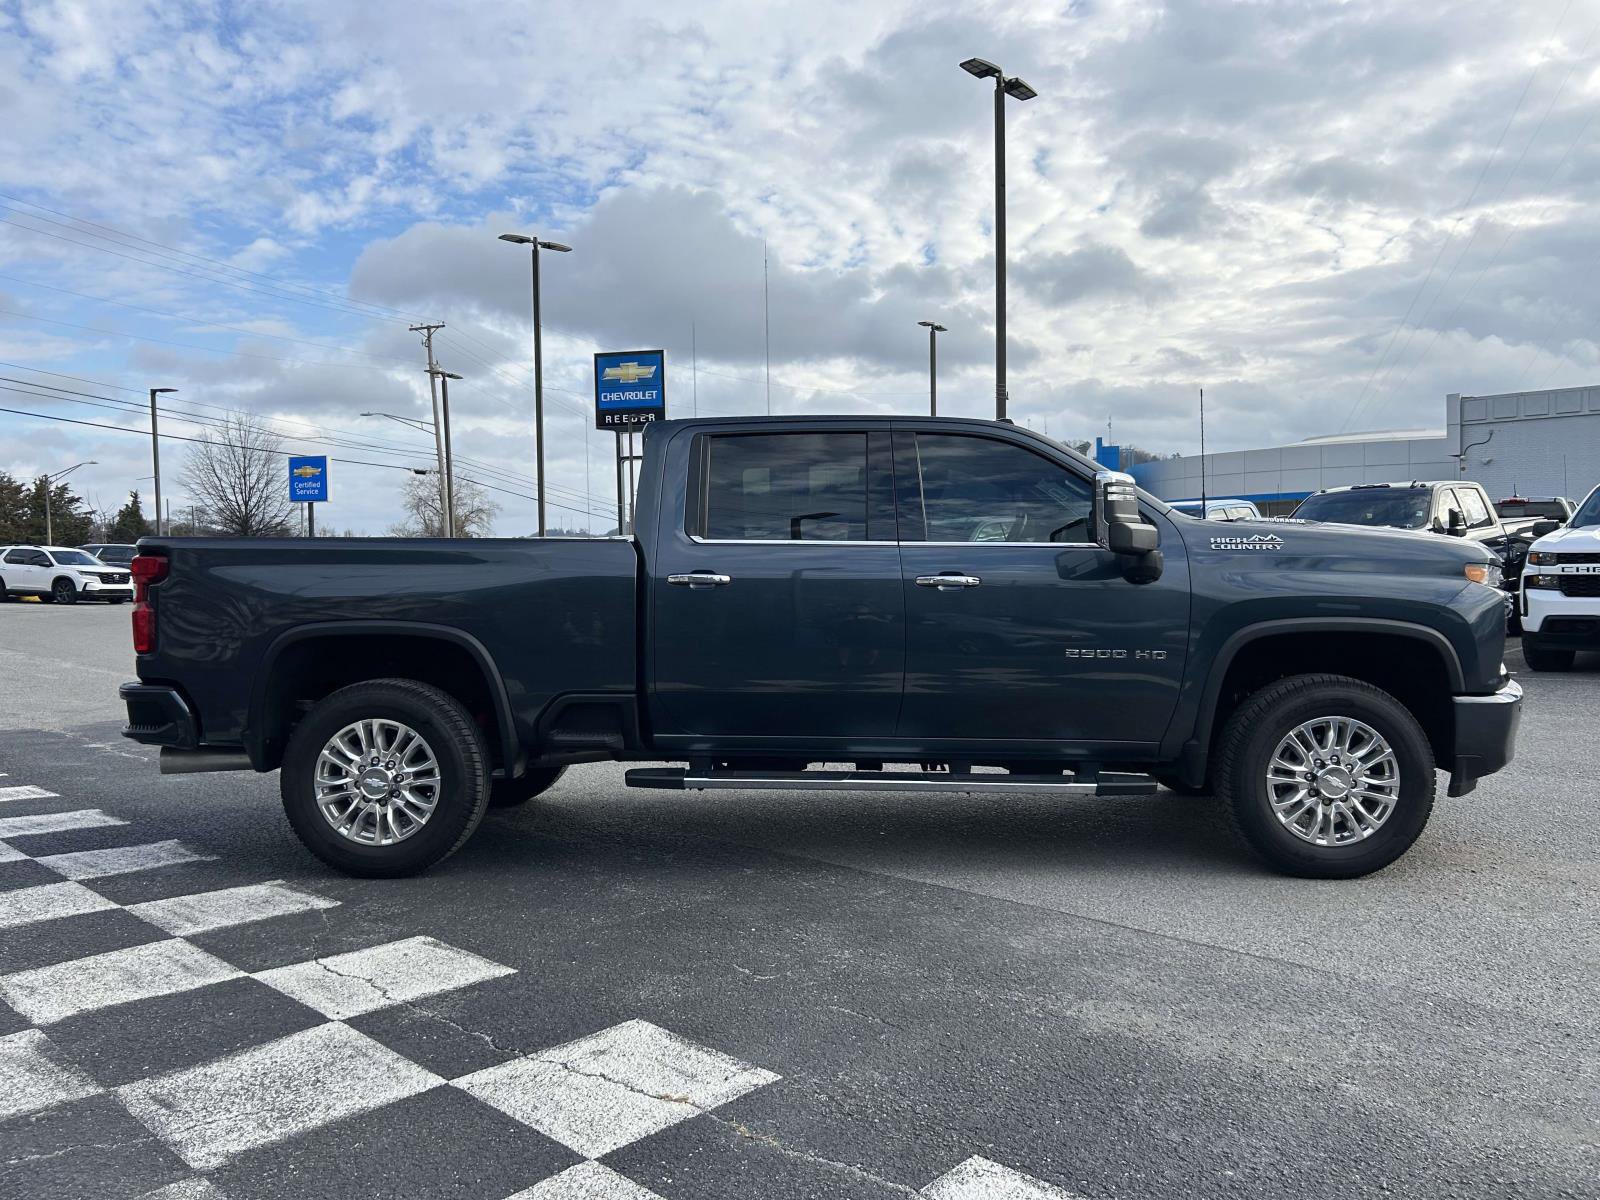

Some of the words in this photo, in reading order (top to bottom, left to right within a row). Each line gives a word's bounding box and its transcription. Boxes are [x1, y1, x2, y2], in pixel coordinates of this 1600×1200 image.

[601, 390, 657, 401] CHEVROLET
[294, 481, 320, 489] Certified
[1065, 648, 1127, 658] 2500
[1135, 650, 1167, 659] HD
